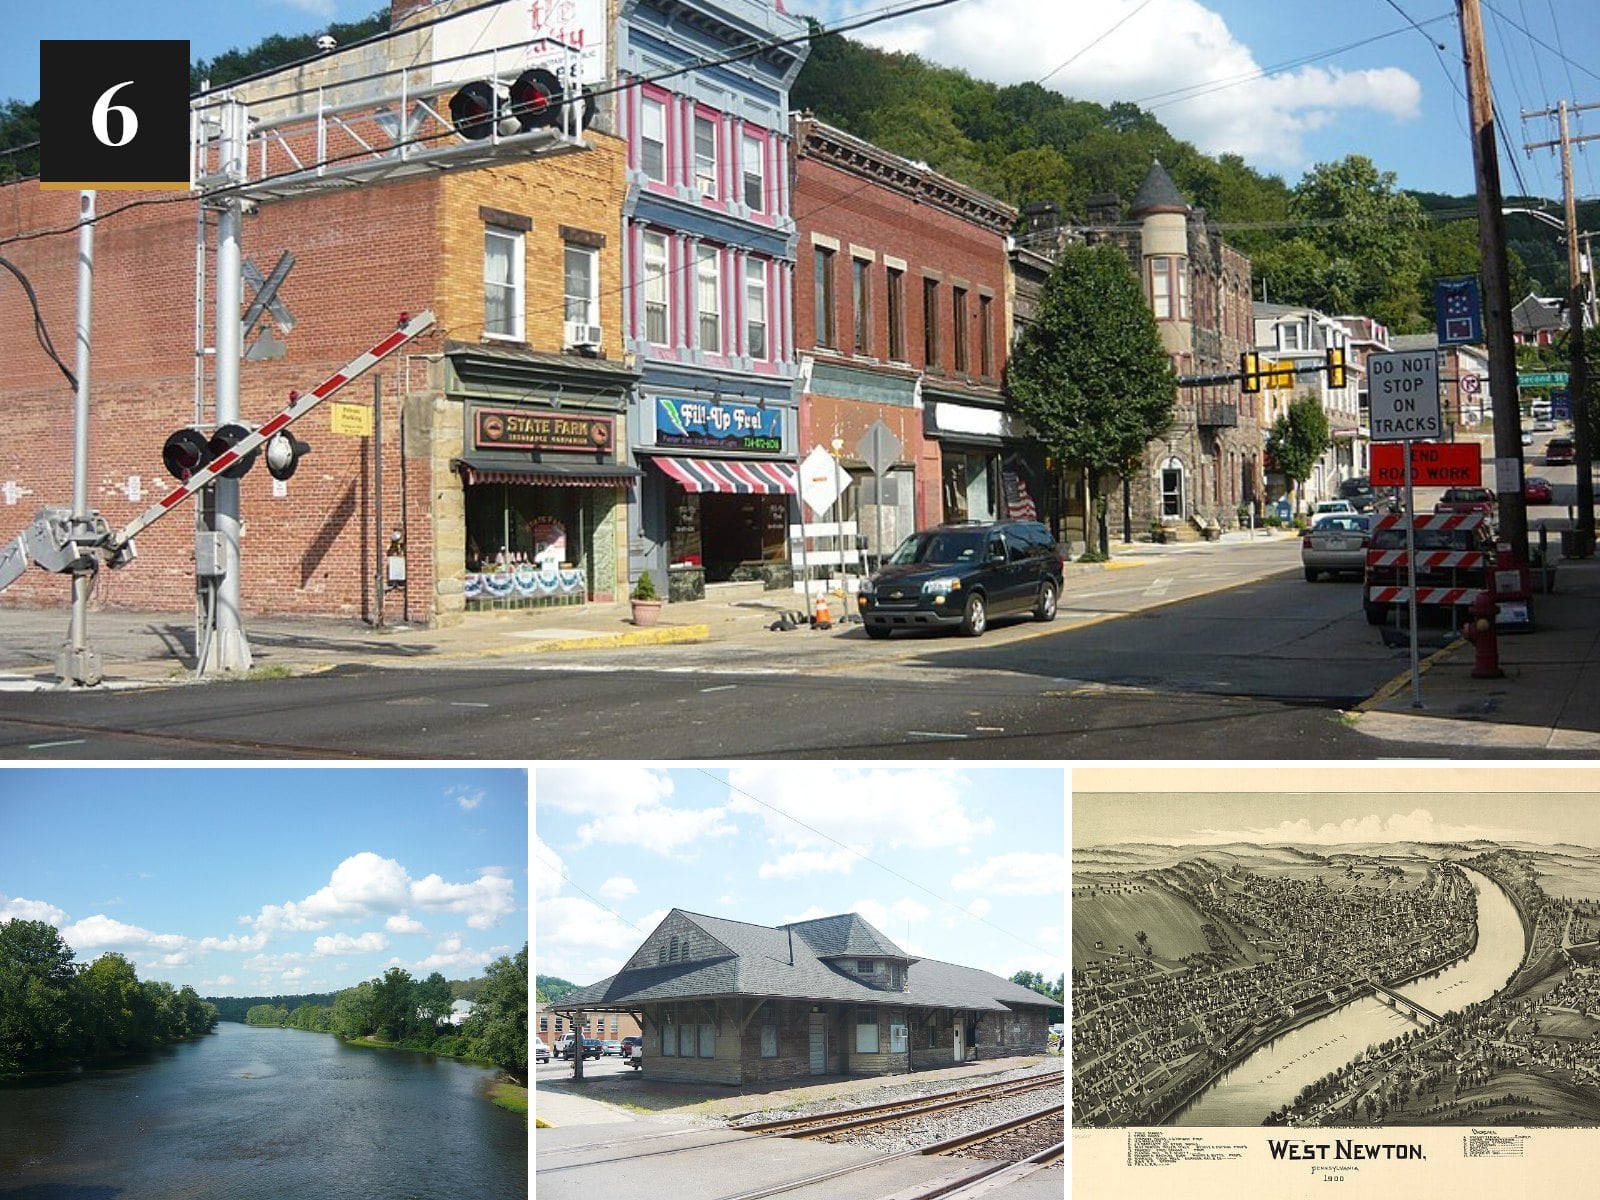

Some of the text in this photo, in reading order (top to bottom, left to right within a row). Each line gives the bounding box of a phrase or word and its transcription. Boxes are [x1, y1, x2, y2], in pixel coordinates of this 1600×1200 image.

[1373, 358, 1432, 375] DO NOT
[1383, 379, 1424, 394] STOP
[1519, 374, 1551, 384] Second
[1393, 398, 1415, 413] ON
[681, 404, 762, 431] Fill-Up Fuel
[1374, 416, 1437, 433] TRACKS
[507, 415, 589, 436] STATE FARM
[1410, 449, 1439, 463] END
[1426, 466, 1470, 480] WORK
[1266, 1139, 1331, 1160] WEST
[1333, 1139, 1427, 1161] NEWTON,
[1323, 1174, 1345, 1182] 1900
